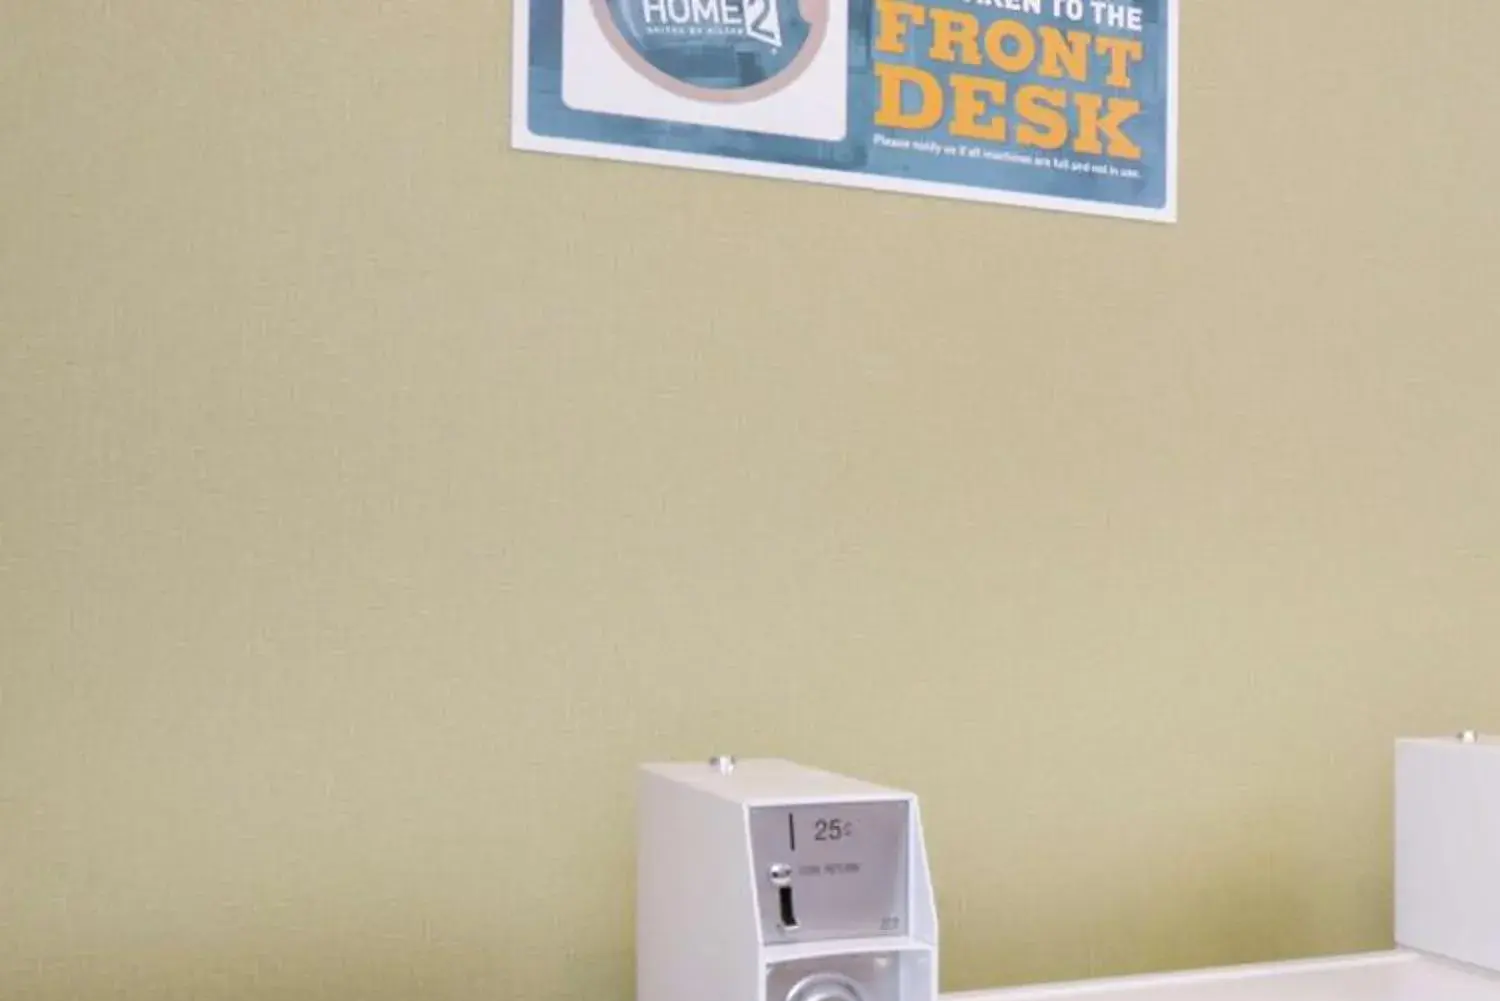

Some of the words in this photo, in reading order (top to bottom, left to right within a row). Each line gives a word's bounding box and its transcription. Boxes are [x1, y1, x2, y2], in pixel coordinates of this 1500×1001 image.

[874, 0, 1143, 89] FRONT
[1052, 0, 1083, 21] TO
[1091, 1, 1143, 31] THE
[873, 62, 1142, 159] DESK
[873, 133, 910, 147] Please
